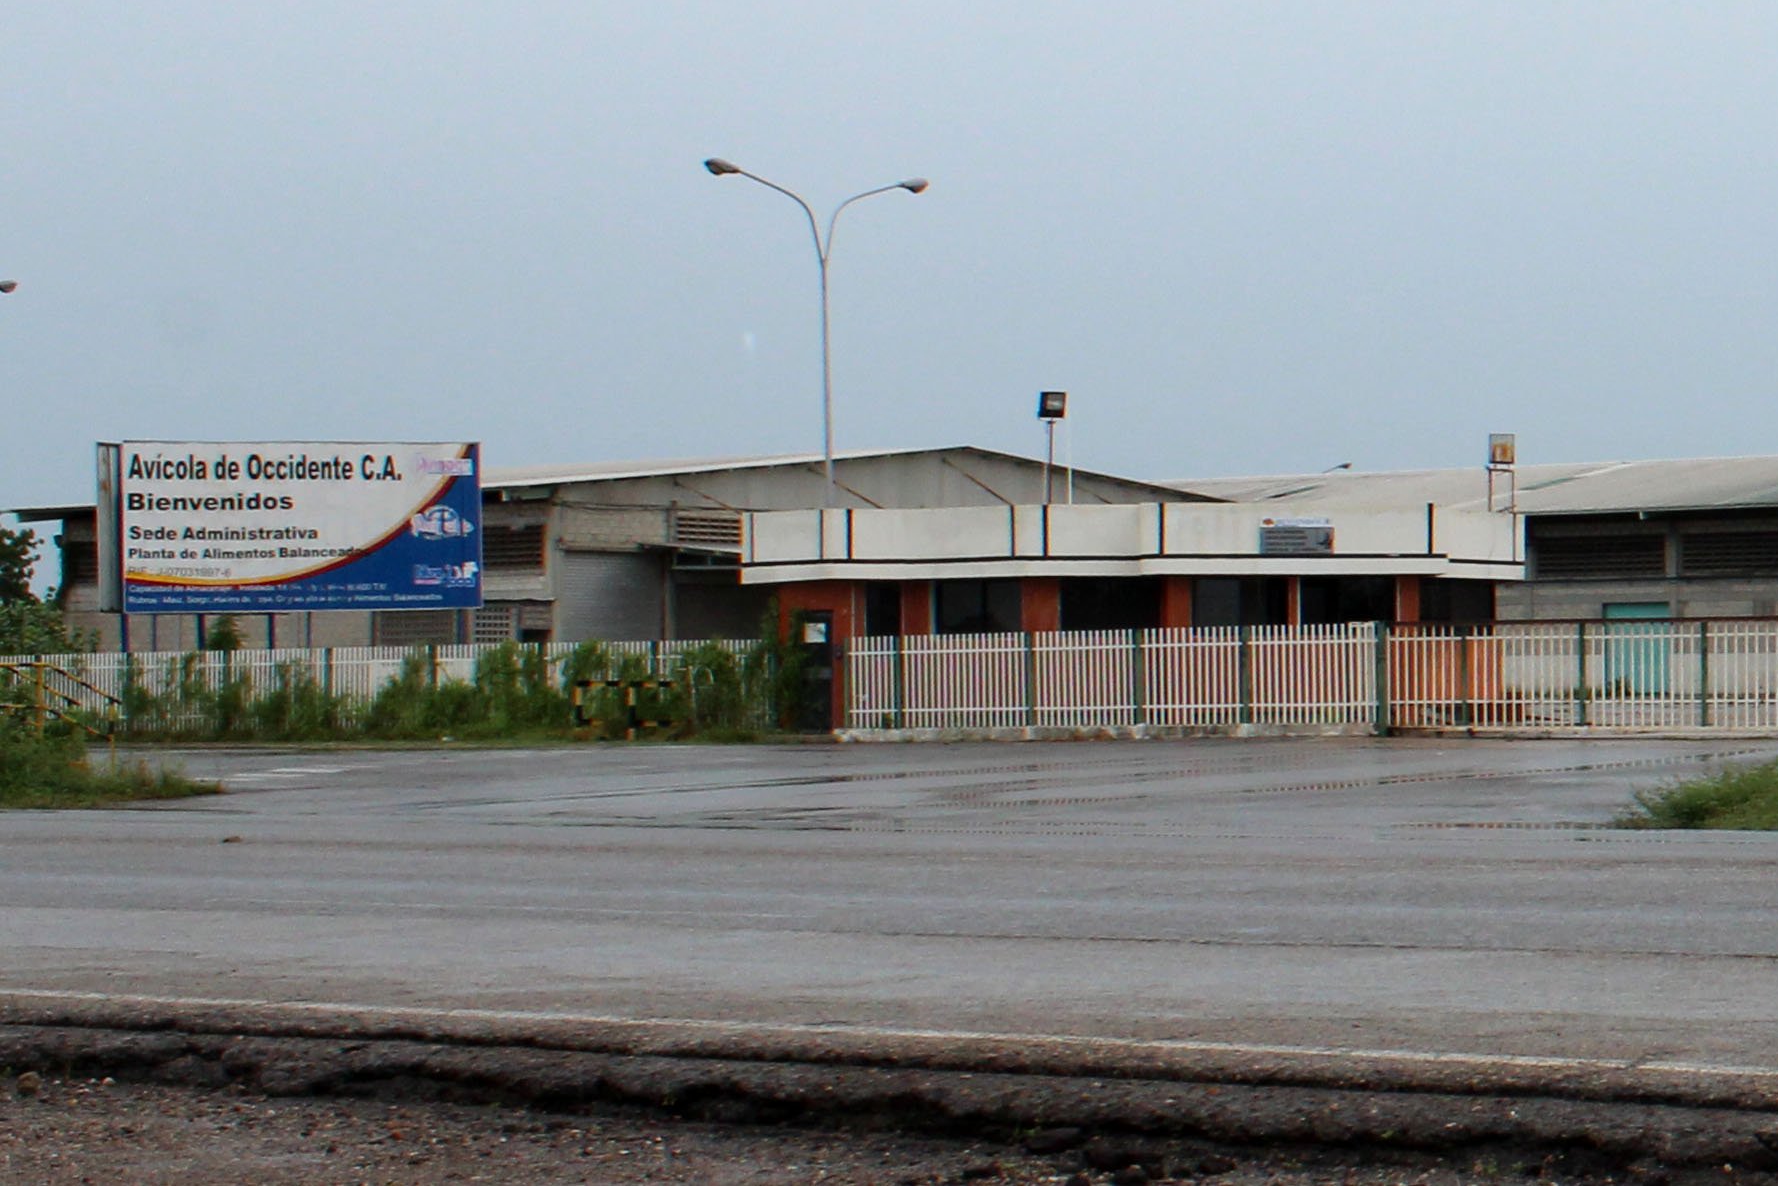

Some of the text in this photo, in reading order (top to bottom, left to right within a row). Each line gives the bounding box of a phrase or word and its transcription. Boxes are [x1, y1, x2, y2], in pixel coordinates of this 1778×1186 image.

[127, 453, 208, 481] Avícola
[214, 454, 240, 481] de
[247, 454, 354, 481] Occidente
[361, 454, 402, 481] C.A.
[127, 493, 294, 511] Bienvenidos
[129, 525, 318, 541] Sede Administrativa
[128, 548, 176, 559] Planta
[180, 548, 198, 559] de
[202, 548, 277, 559] Alimentos
